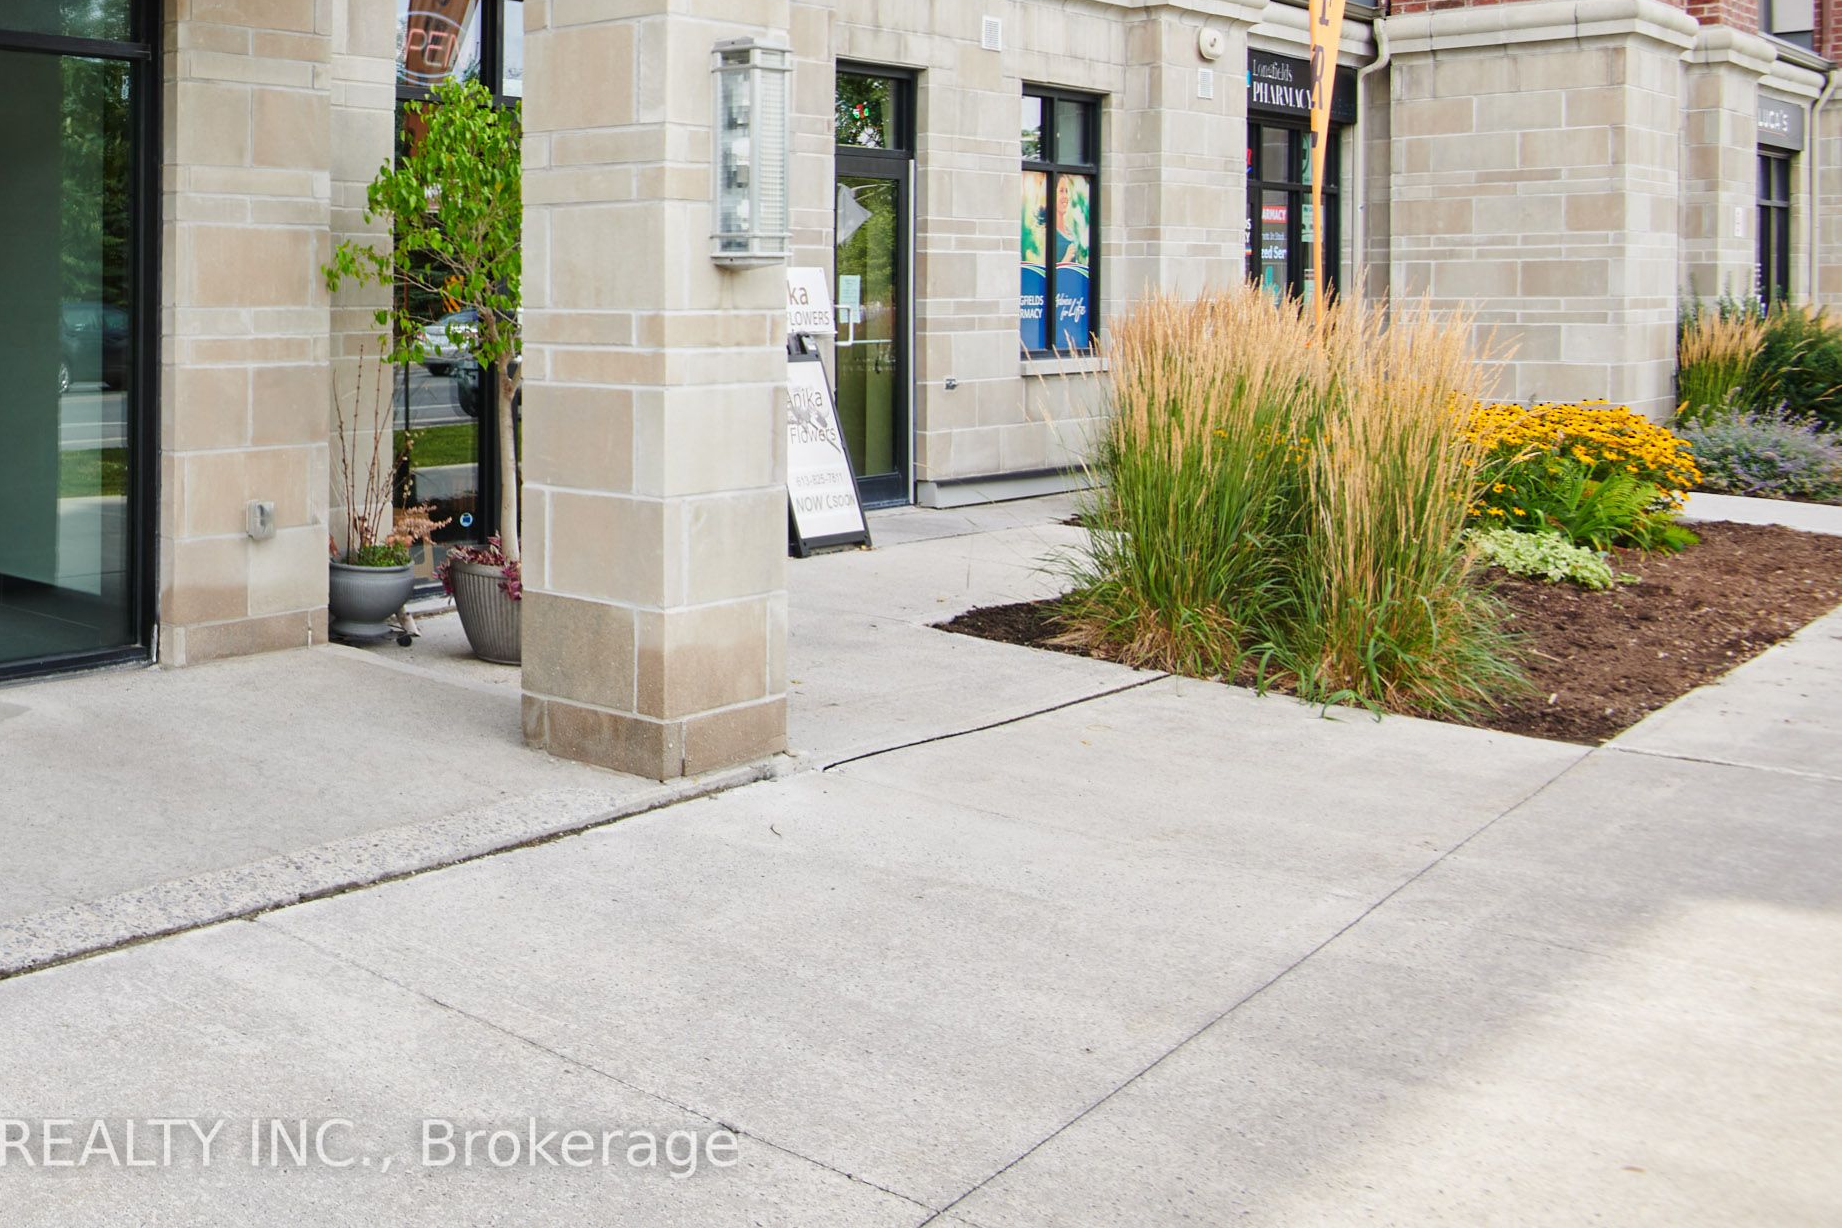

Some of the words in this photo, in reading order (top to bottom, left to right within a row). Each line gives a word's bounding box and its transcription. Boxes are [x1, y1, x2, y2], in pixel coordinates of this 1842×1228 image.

[403, 28, 464, 69] PEN
[1252, 80, 1313, 110] PHARMACY
[789, 310, 830, 326] LOWERS
[790, 426, 837, 445] Flowers
[796, 495, 824, 514] NOW
